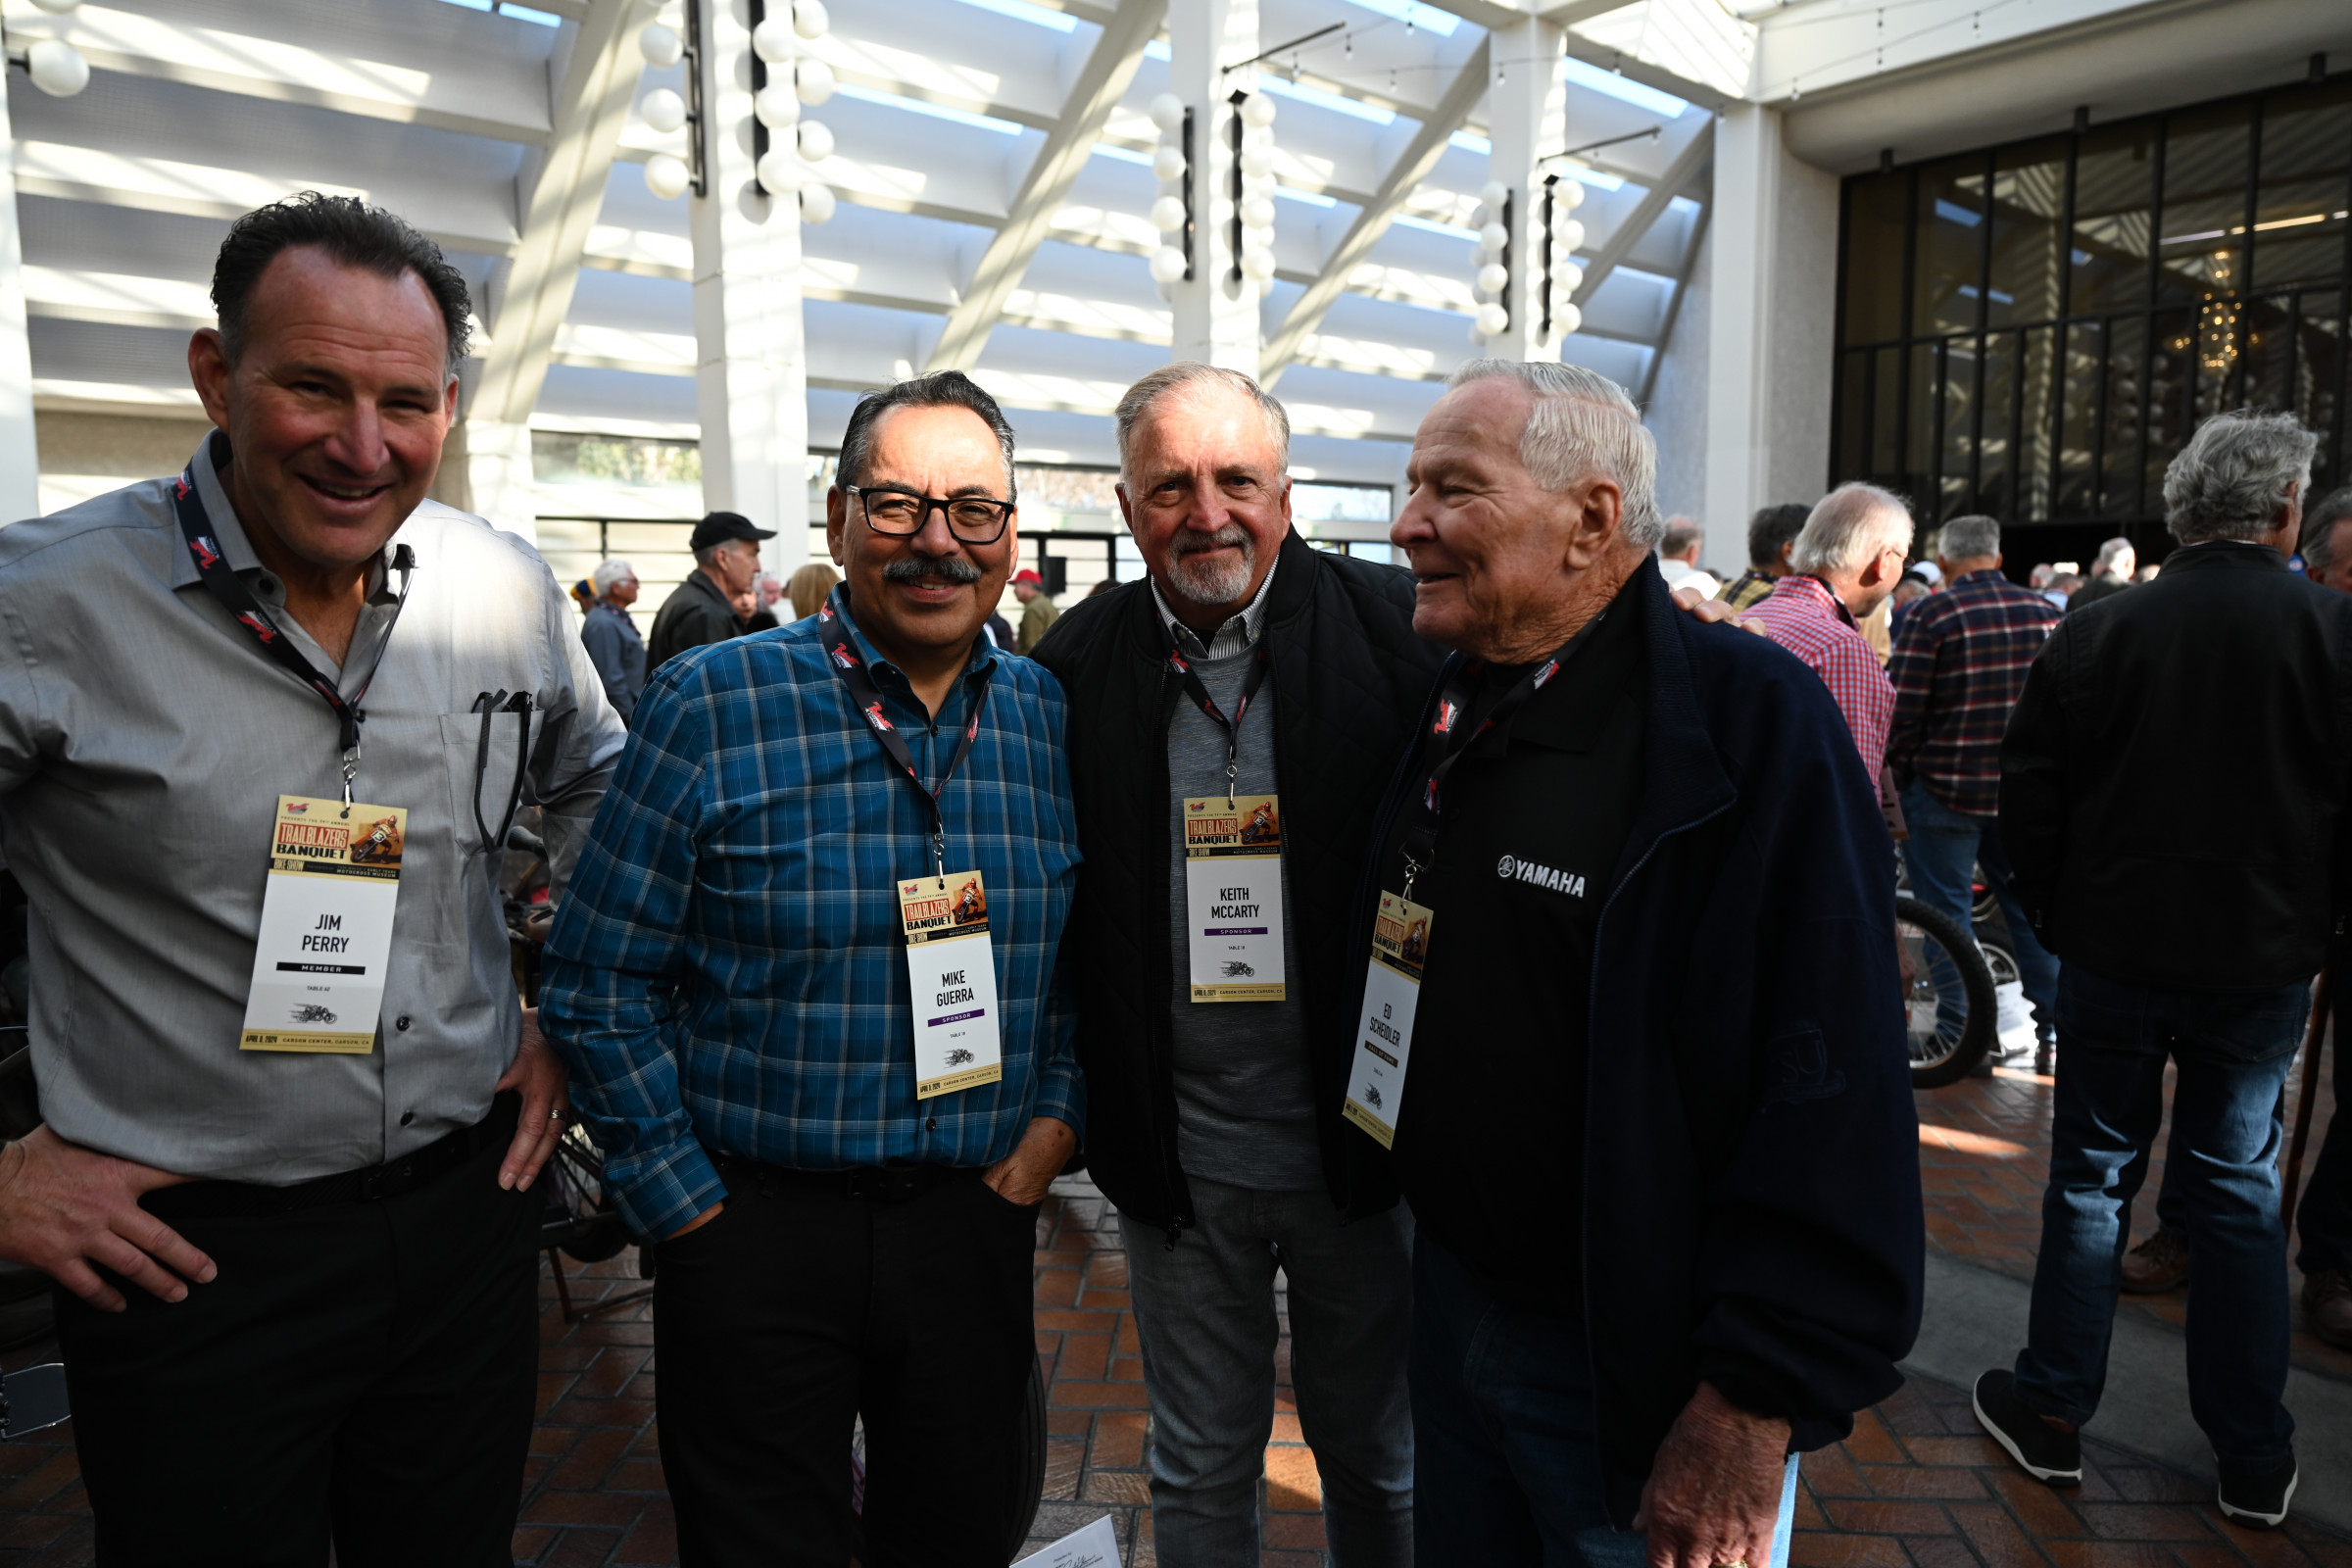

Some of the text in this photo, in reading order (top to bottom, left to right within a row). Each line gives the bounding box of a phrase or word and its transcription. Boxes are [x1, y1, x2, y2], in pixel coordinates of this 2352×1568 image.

[1190, 819, 1237, 835] TRAILBLAZERS
[281, 824, 348, 848] TRAILBLAZERS
[1189, 835, 1238, 845] BANQUET
[276, 844, 347, 858] BANQUET
[286, 859, 305, 871] SHOW
[1516, 859, 1585, 898] YAMAHA
[1220, 888, 1249, 901] KEITH
[906, 900, 950, 921] TRAILBLAZERS
[1211, 905, 1259, 918] MCCARTY
[315, 914, 341, 931] JIM
[906, 915, 951, 931] BANQUET
[302, 935, 350, 953] PERRY
[1375, 934, 1401, 954] BANQUET
[942, 970, 965, 987] MIKE
[937, 988, 974, 1006] GUERRA
[943, 1013, 970, 1022] SPONSOR
[1384, 1004, 1392, 1019] ED
[1370, 1016, 1400, 1048] SCHEIDLER
